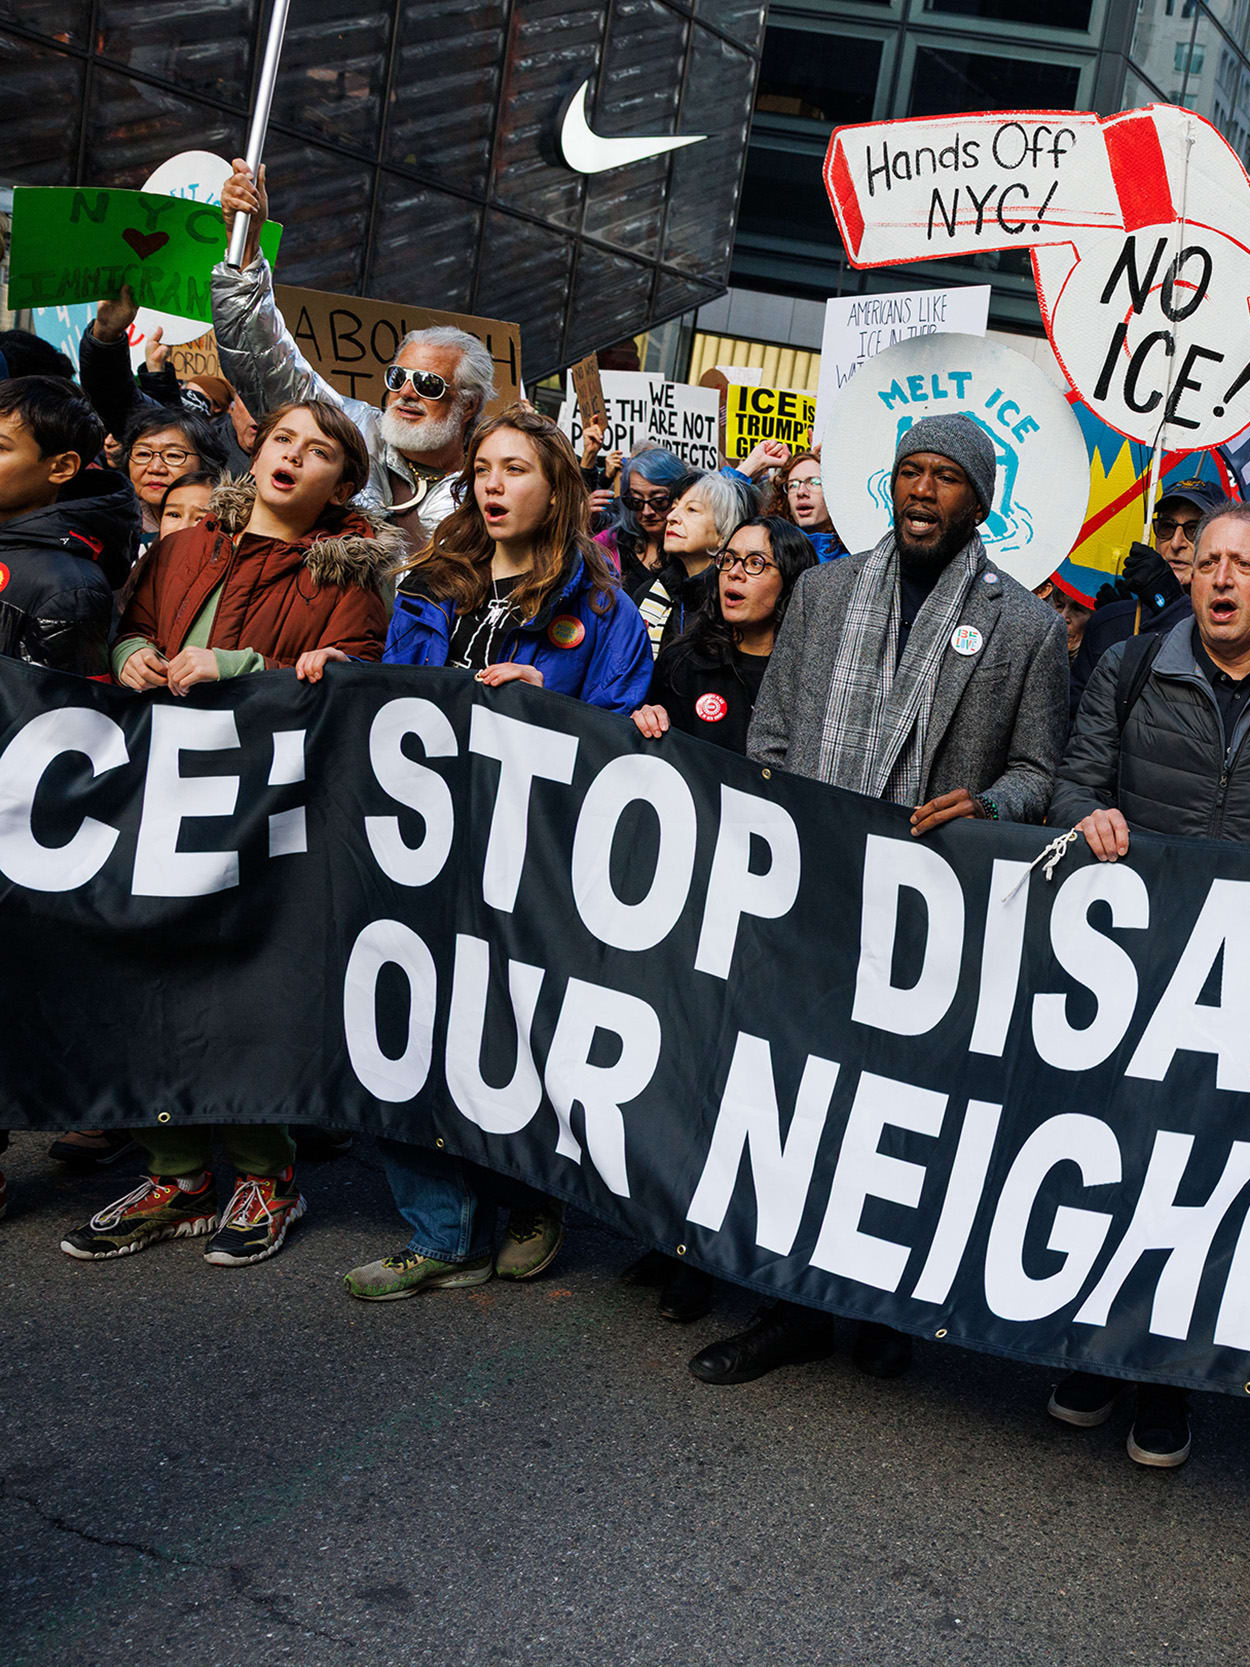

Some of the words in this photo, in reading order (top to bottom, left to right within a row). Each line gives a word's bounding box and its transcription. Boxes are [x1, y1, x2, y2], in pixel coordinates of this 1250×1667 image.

[865, 132, 980, 197] Hands
[993, 121, 1076, 169] Off
[927, 180, 1058, 240] NYC!
[18, 263, 212, 318] IMMIGRAN
[1100, 236, 1213, 322] NO
[847, 298, 912, 326] AMERICANS
[919, 294, 948, 323] LIKE
[857, 330, 882, 359] ICE
[649, 381, 675, 408] WE
[738, 386, 798, 418] ICE
[877, 371, 973, 410] MELT
[984, 387, 1040, 443] ICE
[648, 408, 677, 436] ARE
[683, 411, 715, 443] NOT
[364, 697, 801, 979] STOP
[344, 918, 662, 1197] OUR
